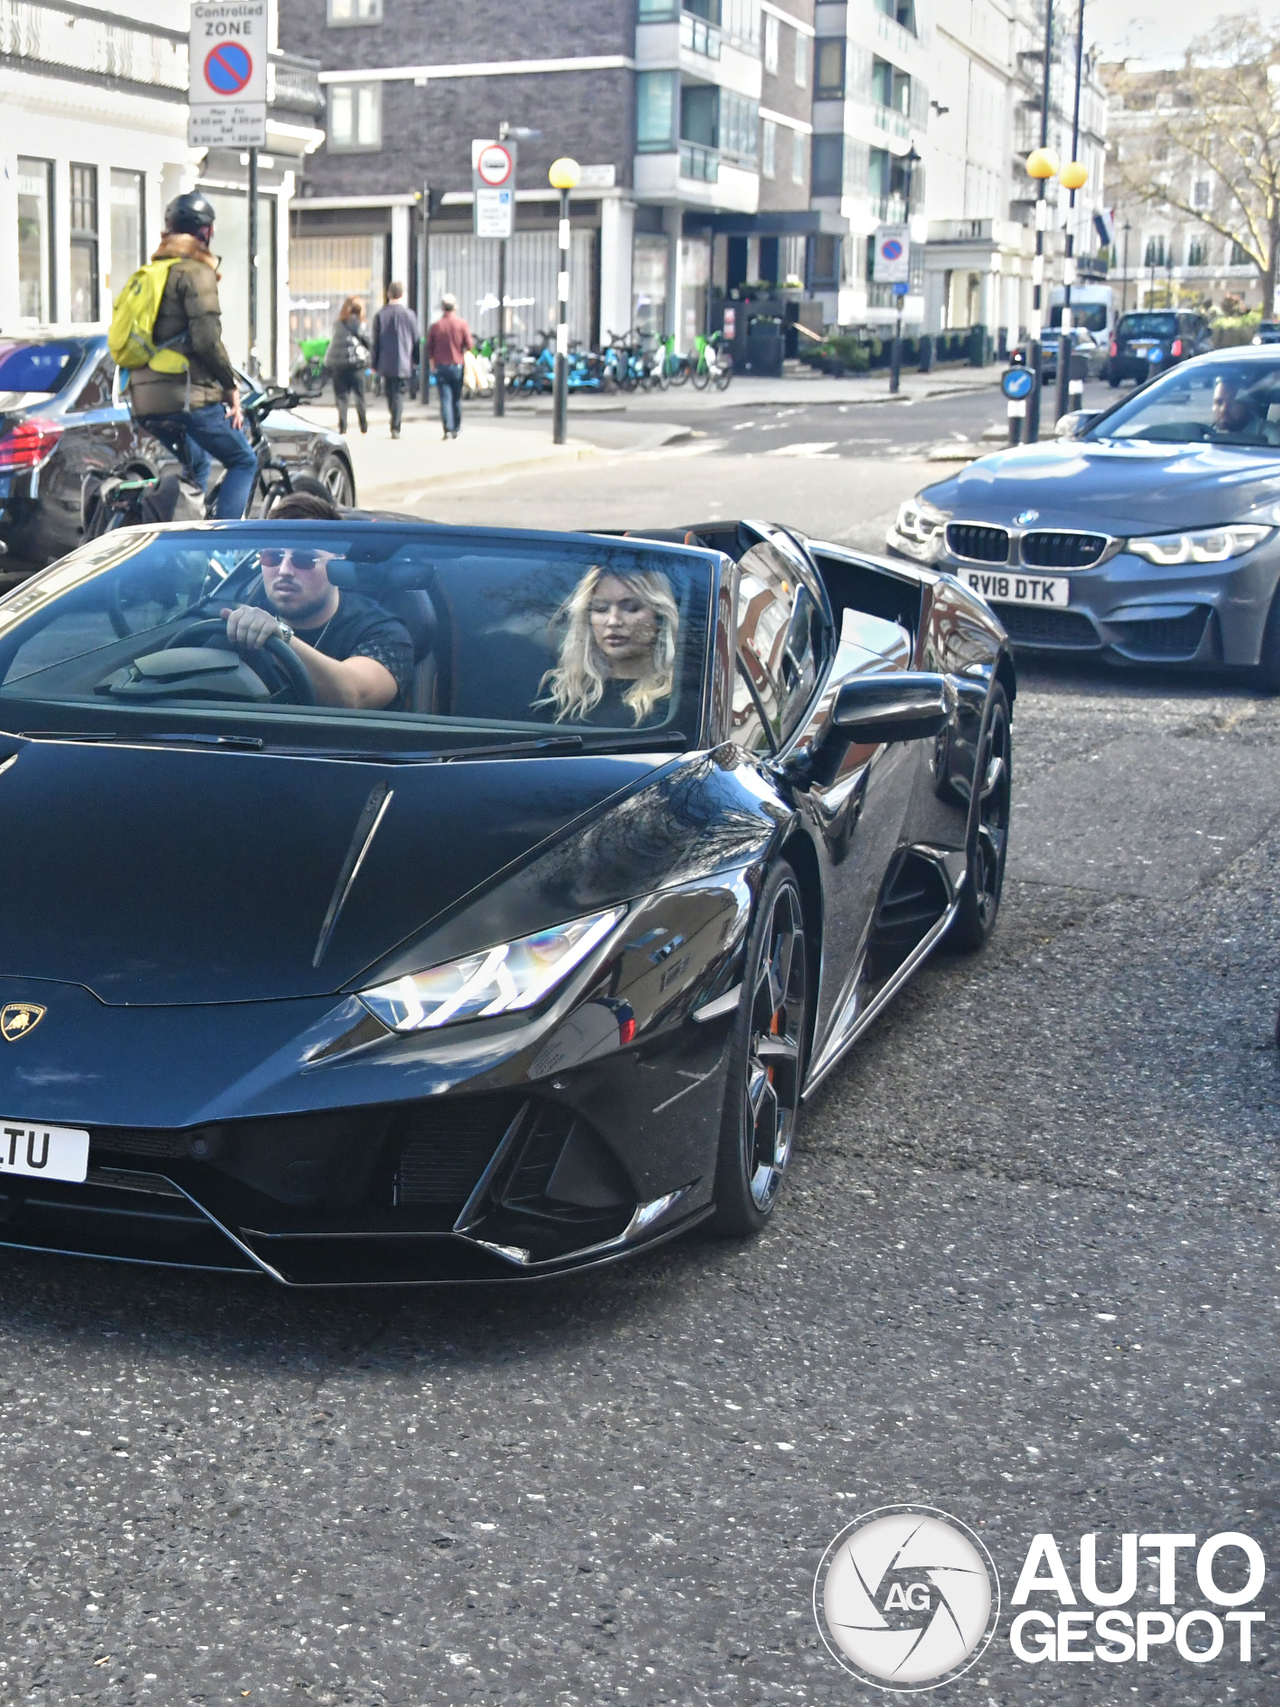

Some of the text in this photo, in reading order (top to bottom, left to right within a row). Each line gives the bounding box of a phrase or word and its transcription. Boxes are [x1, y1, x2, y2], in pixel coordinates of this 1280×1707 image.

[195, 5, 263, 18] Controlled
[205, 21, 252, 36] ZONE
[968, 574, 1055, 602] RV18 DTK
